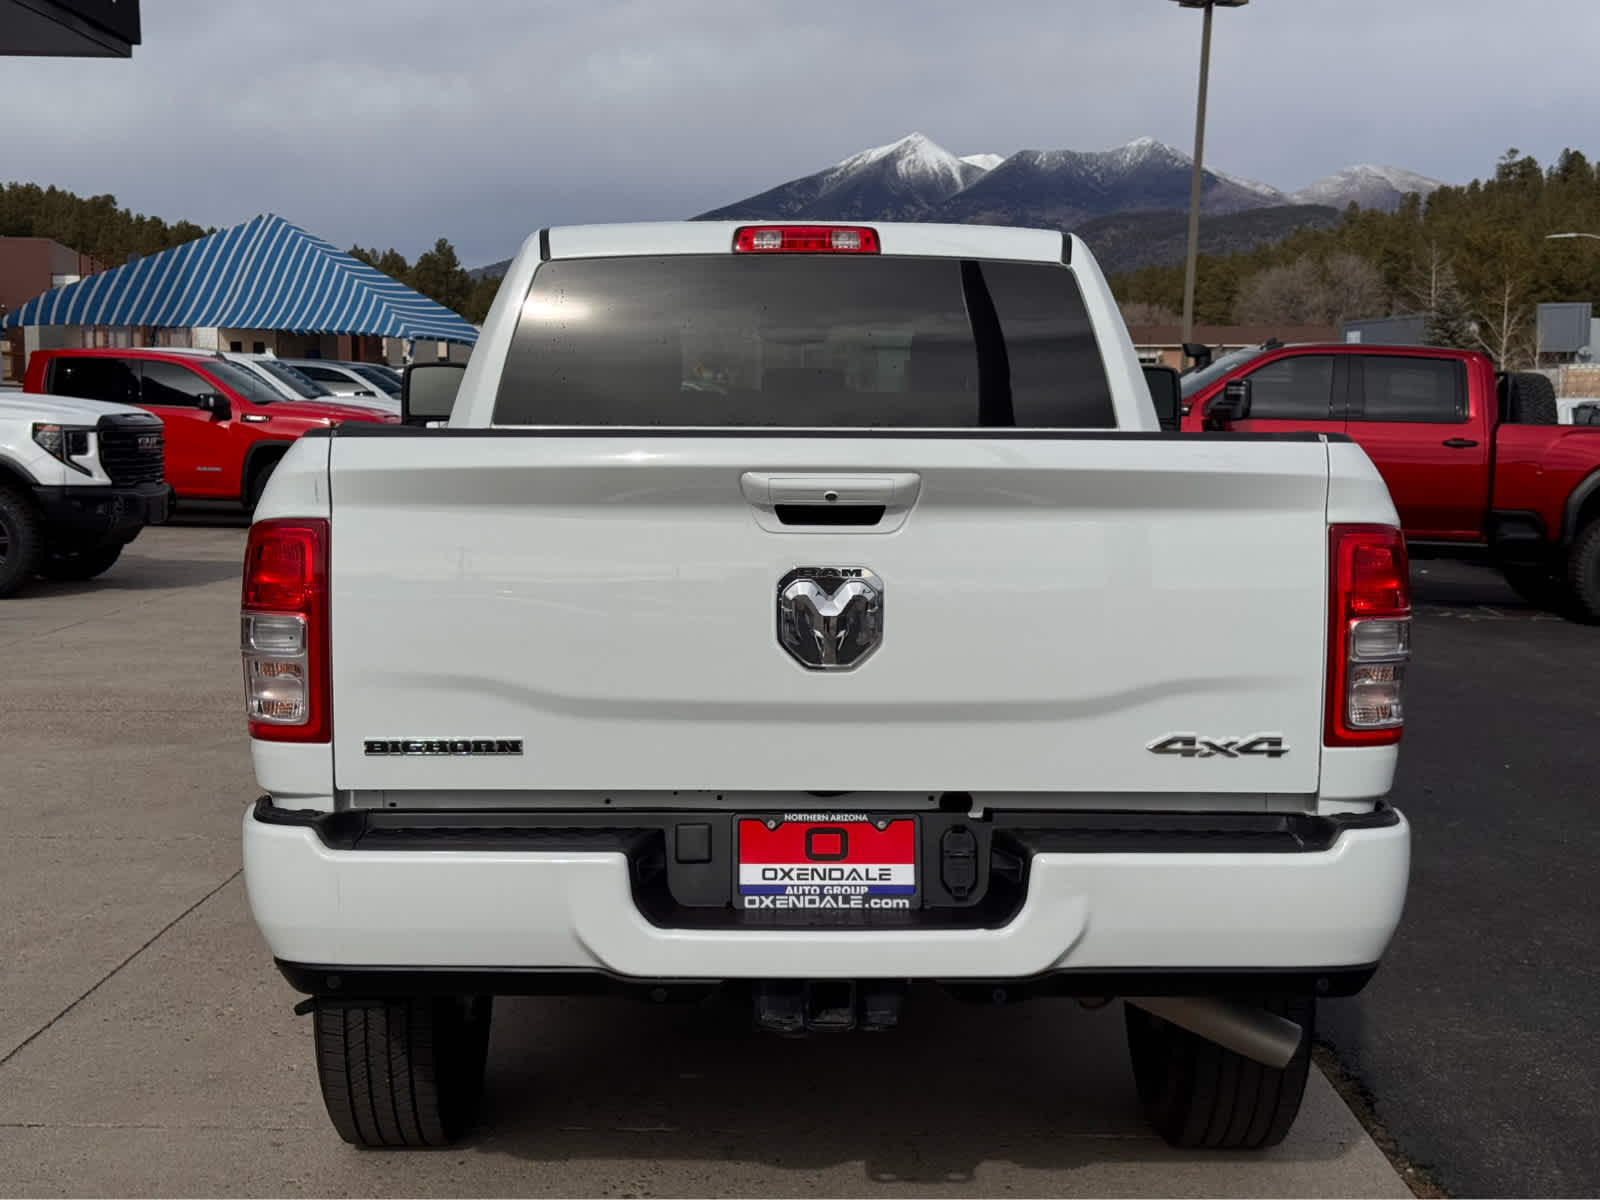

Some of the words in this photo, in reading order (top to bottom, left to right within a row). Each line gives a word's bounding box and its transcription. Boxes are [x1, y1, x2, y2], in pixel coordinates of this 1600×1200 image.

[364, 739, 523, 756] BIGHORN
[784, 813, 829, 822] NORTHERN
[830, 813, 869, 822] ARIZONA
[761, 867, 892, 882] OXENDALE
[784, 885, 820, 895] AUTO
[823, 885, 869, 895] GROUP
[743, 895, 910, 909] OXENDALE.com
